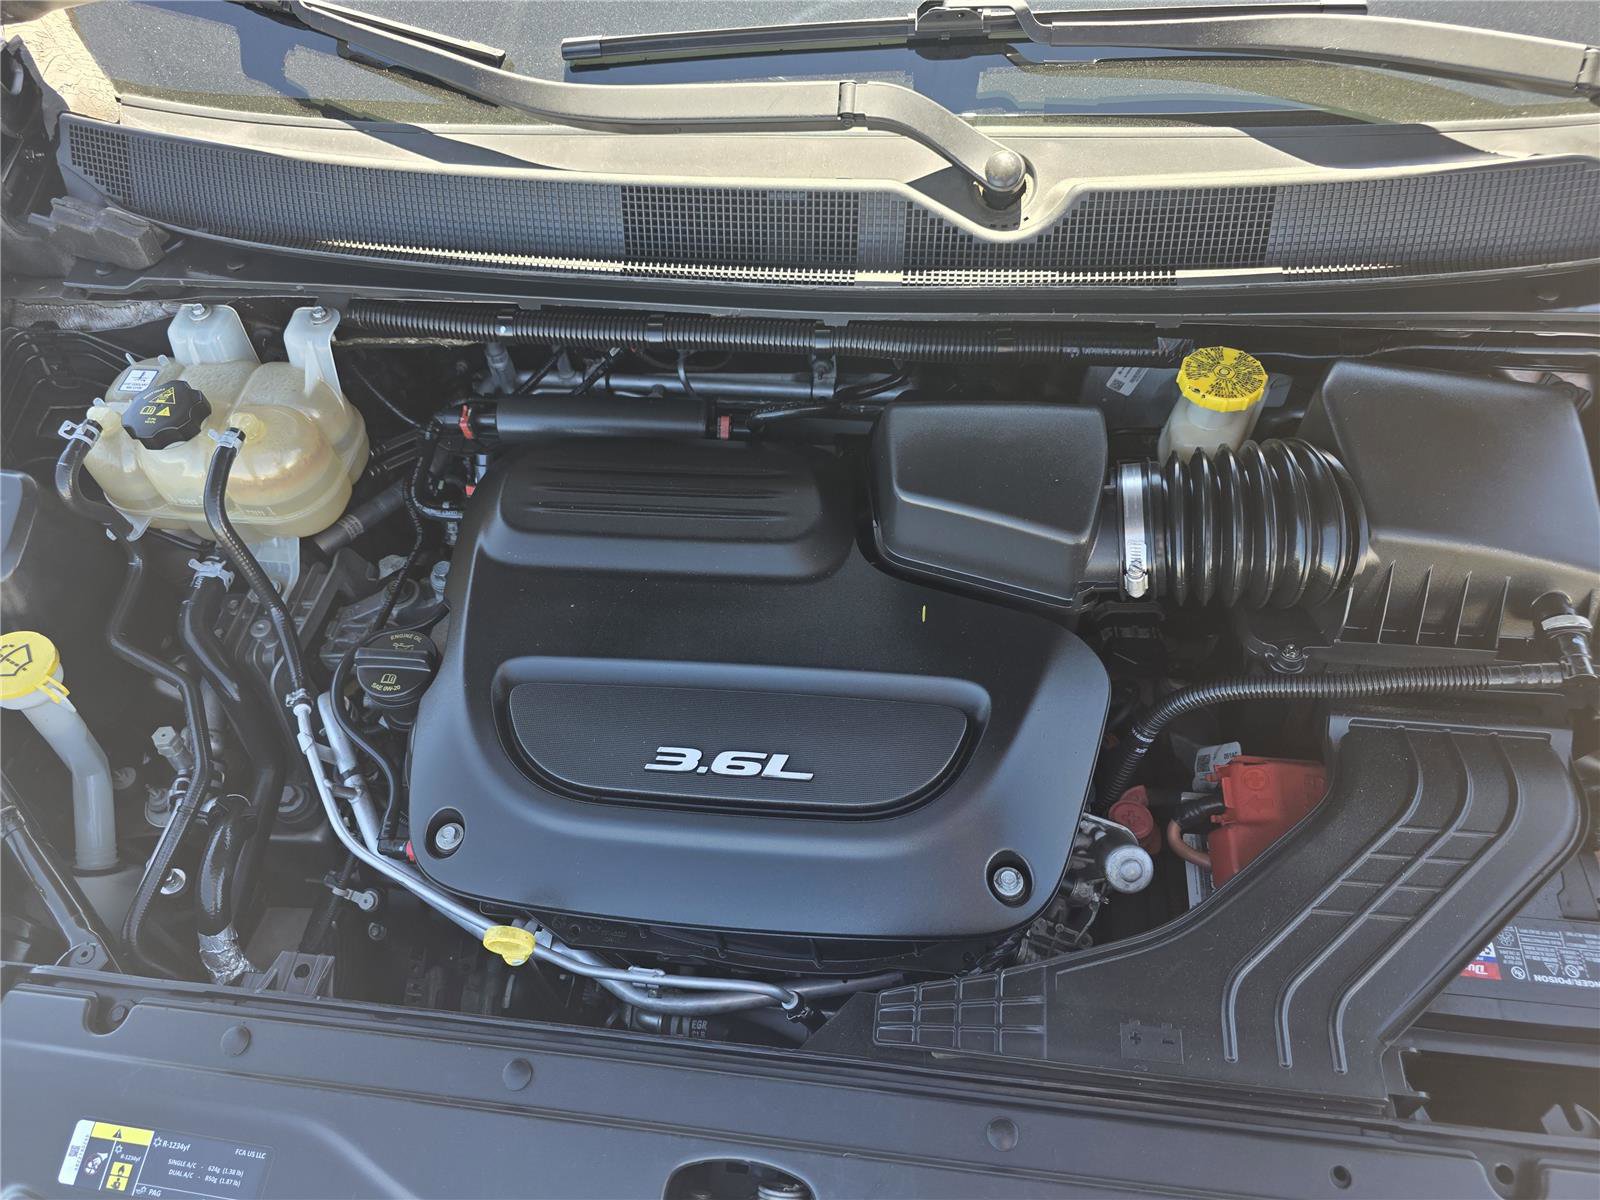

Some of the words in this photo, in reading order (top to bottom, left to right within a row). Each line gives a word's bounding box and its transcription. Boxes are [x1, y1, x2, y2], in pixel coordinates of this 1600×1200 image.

[390, 633, 413, 641] ENGINE
[413, 634, 423, 643] OIL
[371, 682, 383, 691] SAE
[644, 746, 814, 781] 3.6L
[692, 1019, 708, 1030] EGR
[161, 1140, 191, 1152] R-1234yf
[234, 1148, 247, 1156] FCA
[255, 1151, 267, 1159] LLC
[167, 1158, 187, 1168] SINGLE
[187, 1161, 198, 1169] A/C
[168, 1169, 182, 1177] DUAL
[182, 1171, 194, 1179] A/C
[148, 1188, 162, 1198] PAG
